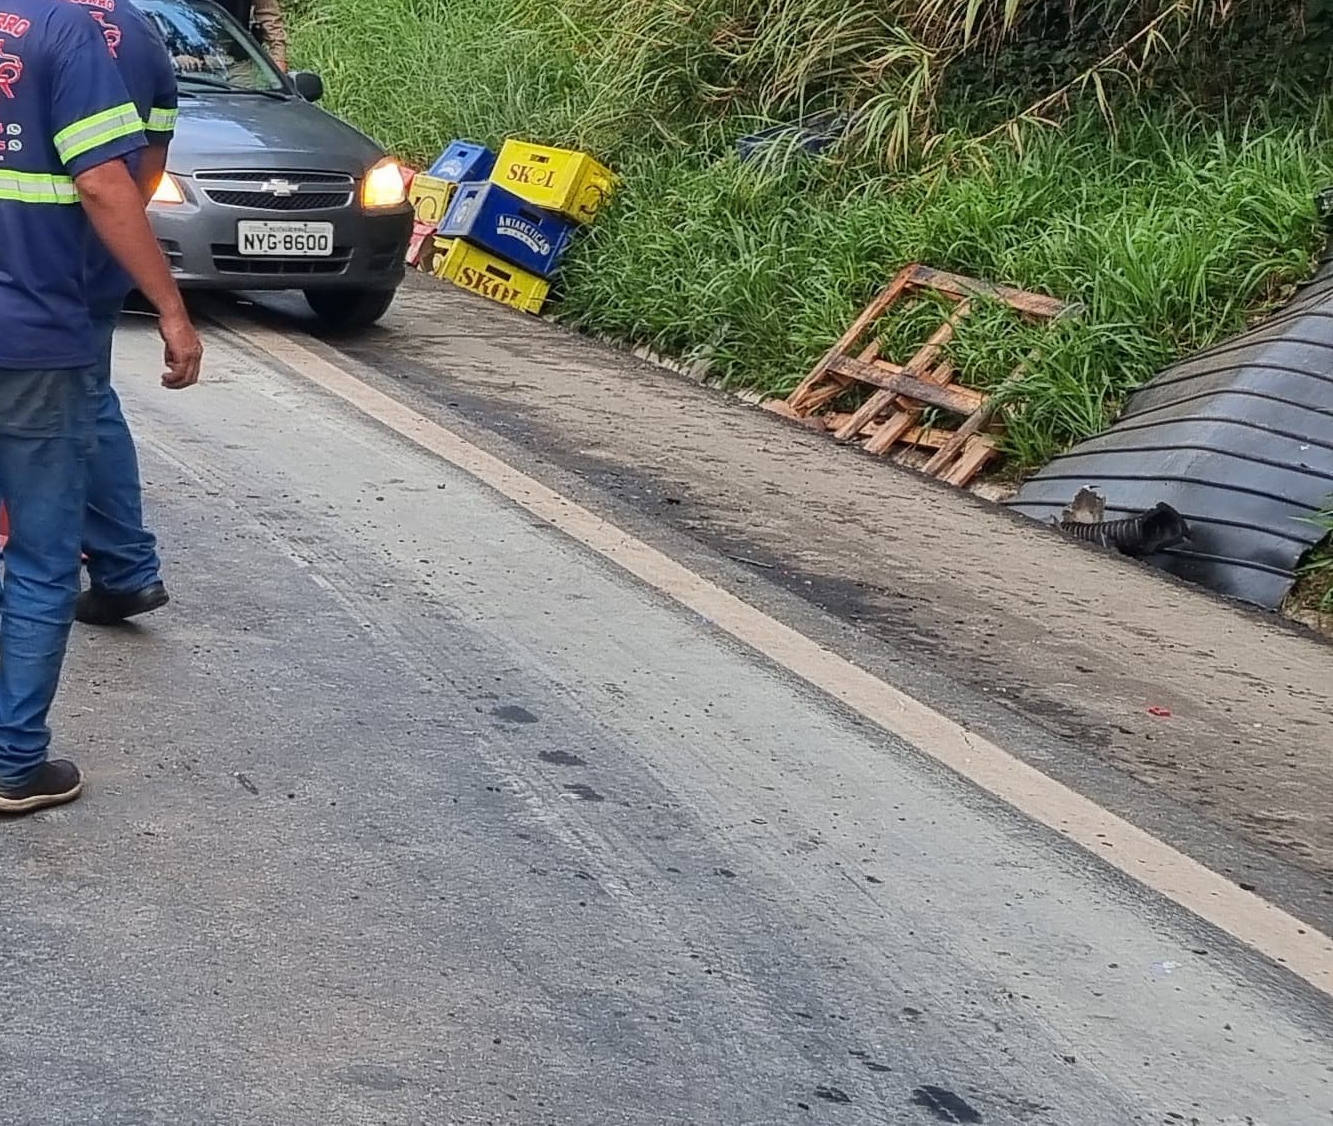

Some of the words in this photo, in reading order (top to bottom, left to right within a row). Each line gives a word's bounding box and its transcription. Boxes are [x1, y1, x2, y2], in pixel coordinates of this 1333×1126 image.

[506, 163, 556, 189] SKOL
[498, 215, 546, 246] ANTARCTICA
[458, 266, 523, 303] SKOL
